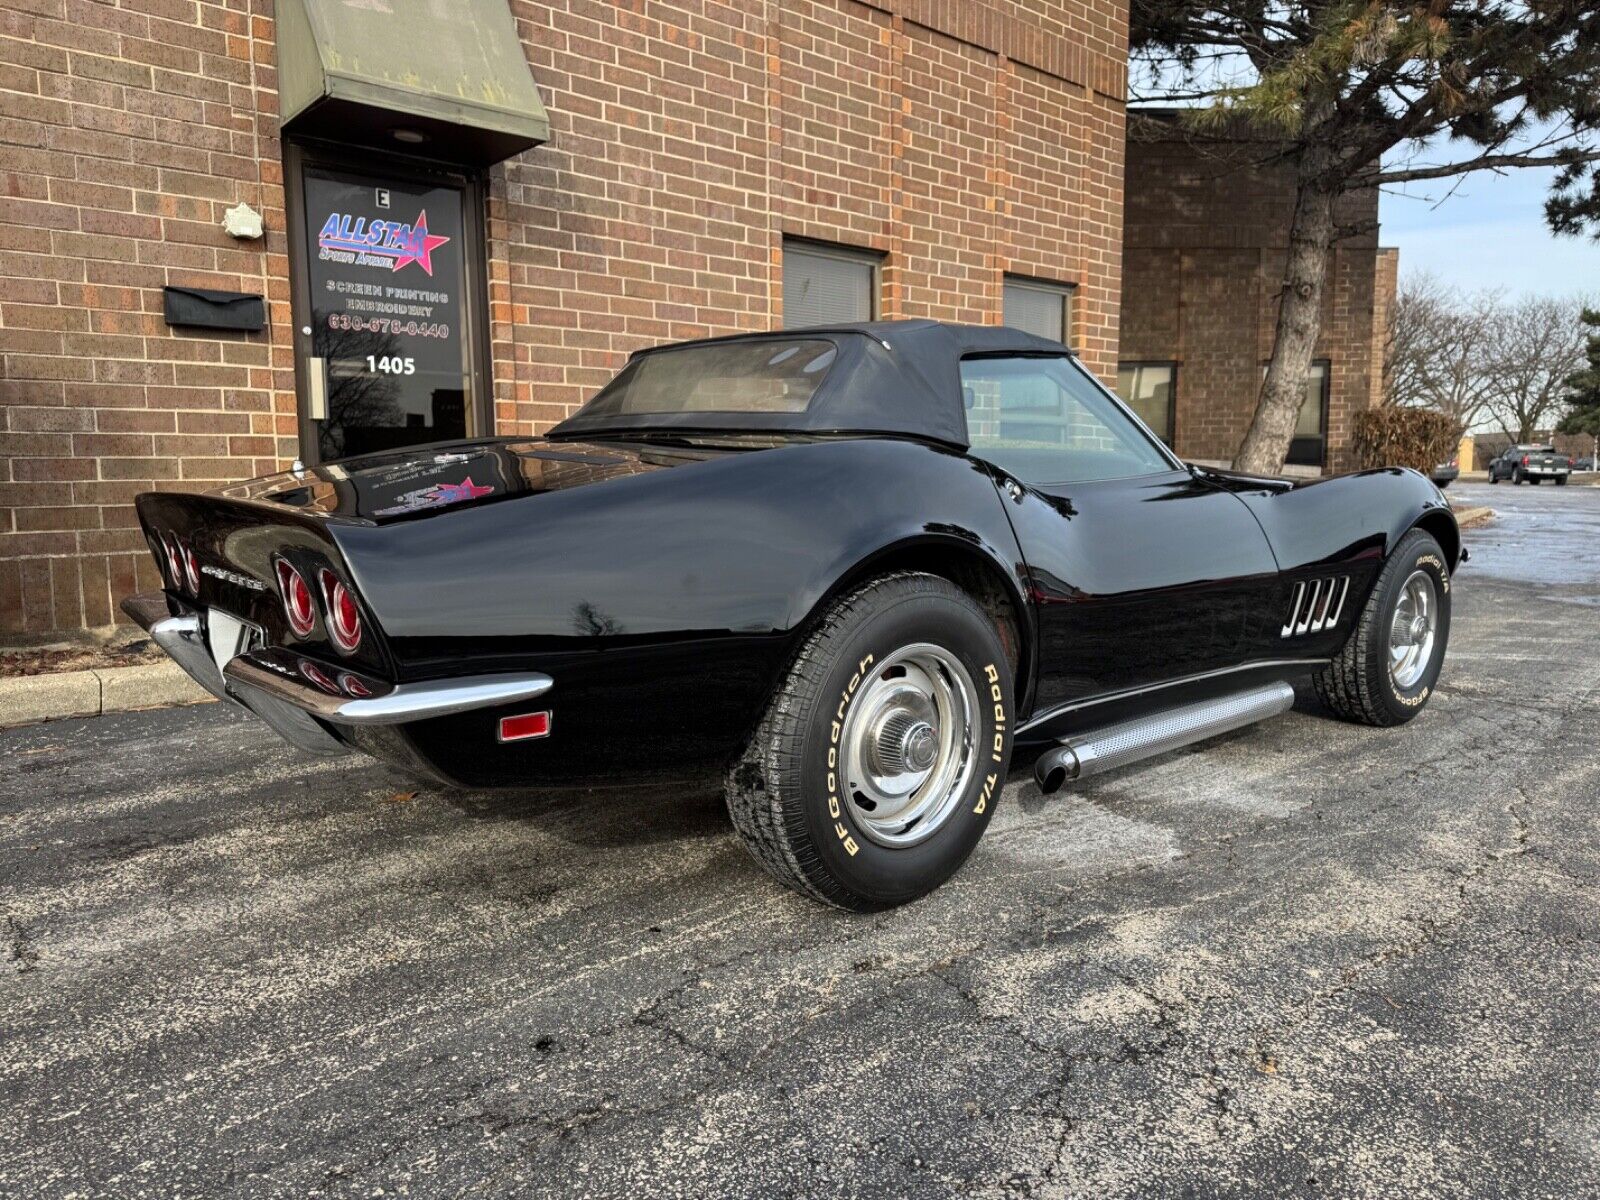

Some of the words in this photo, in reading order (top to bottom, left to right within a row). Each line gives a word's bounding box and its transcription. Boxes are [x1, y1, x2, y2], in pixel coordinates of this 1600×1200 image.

[378, 189, 389, 207] E
[319, 213, 428, 254] ALLSTAR
[326, 280, 382, 297] SCREEN
[385, 287, 448, 303] PRINTING
[345, 299, 434, 317] EMBROIDERY
[328, 313, 449, 338] 630-678-0440
[366, 355, 415, 375] 1405
[984, 664, 1006, 762] Radial
[828, 654, 874, 857] BFGoodrich
[972, 773, 998, 814] T/A
